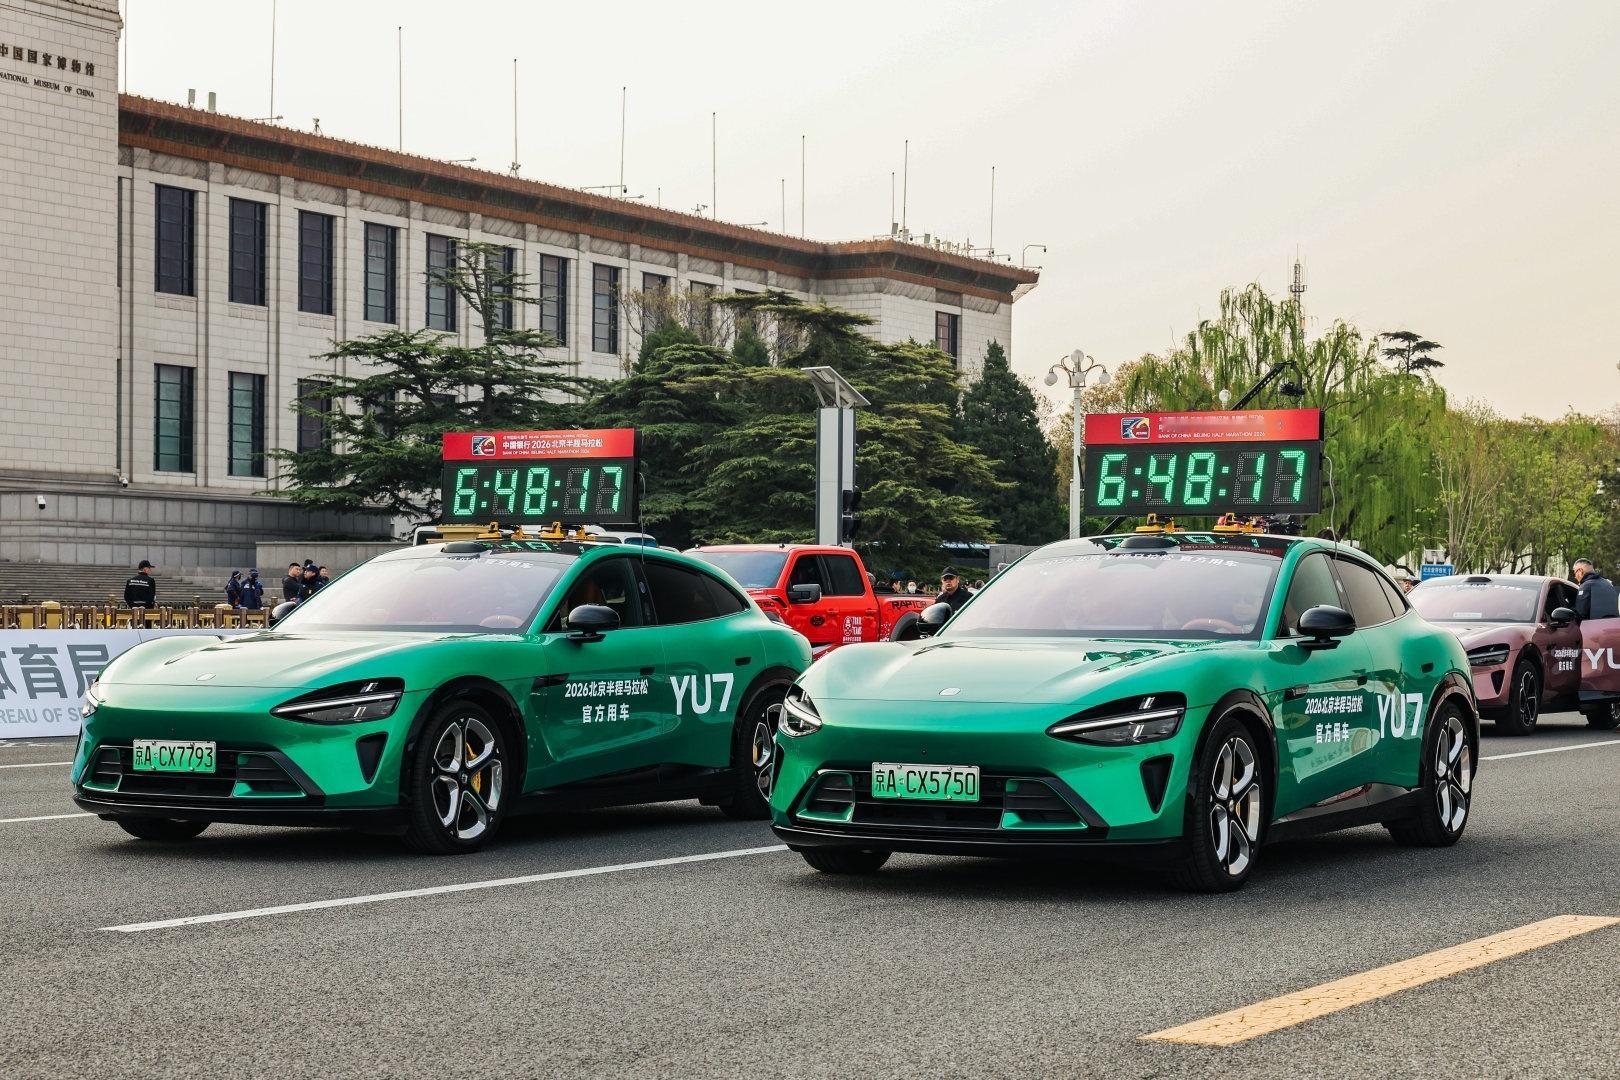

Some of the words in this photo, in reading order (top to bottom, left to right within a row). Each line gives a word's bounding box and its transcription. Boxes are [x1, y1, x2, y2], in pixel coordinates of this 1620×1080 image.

[33, 78, 60, 91] MUSEUM
[64, 85, 72, 93] OF
[76, 88, 95, 98] CHINA
[1097, 450, 1306, 506] 6:48:17
[453, 466, 623, 516] 6:48:17
[565, 679, 648, 698] 2026北京半程马拉松
[670, 673, 734, 715] YU7
[42, 708, 62, 722] OF
[67, 707, 82, 722] S
[582, 703, 629, 723] 官方用车
[1304, 695, 1363, 715] 2026北京半程马拉松
[1377, 692, 1423, 738] YU7
[1315, 722, 1349, 743] 官方用车
